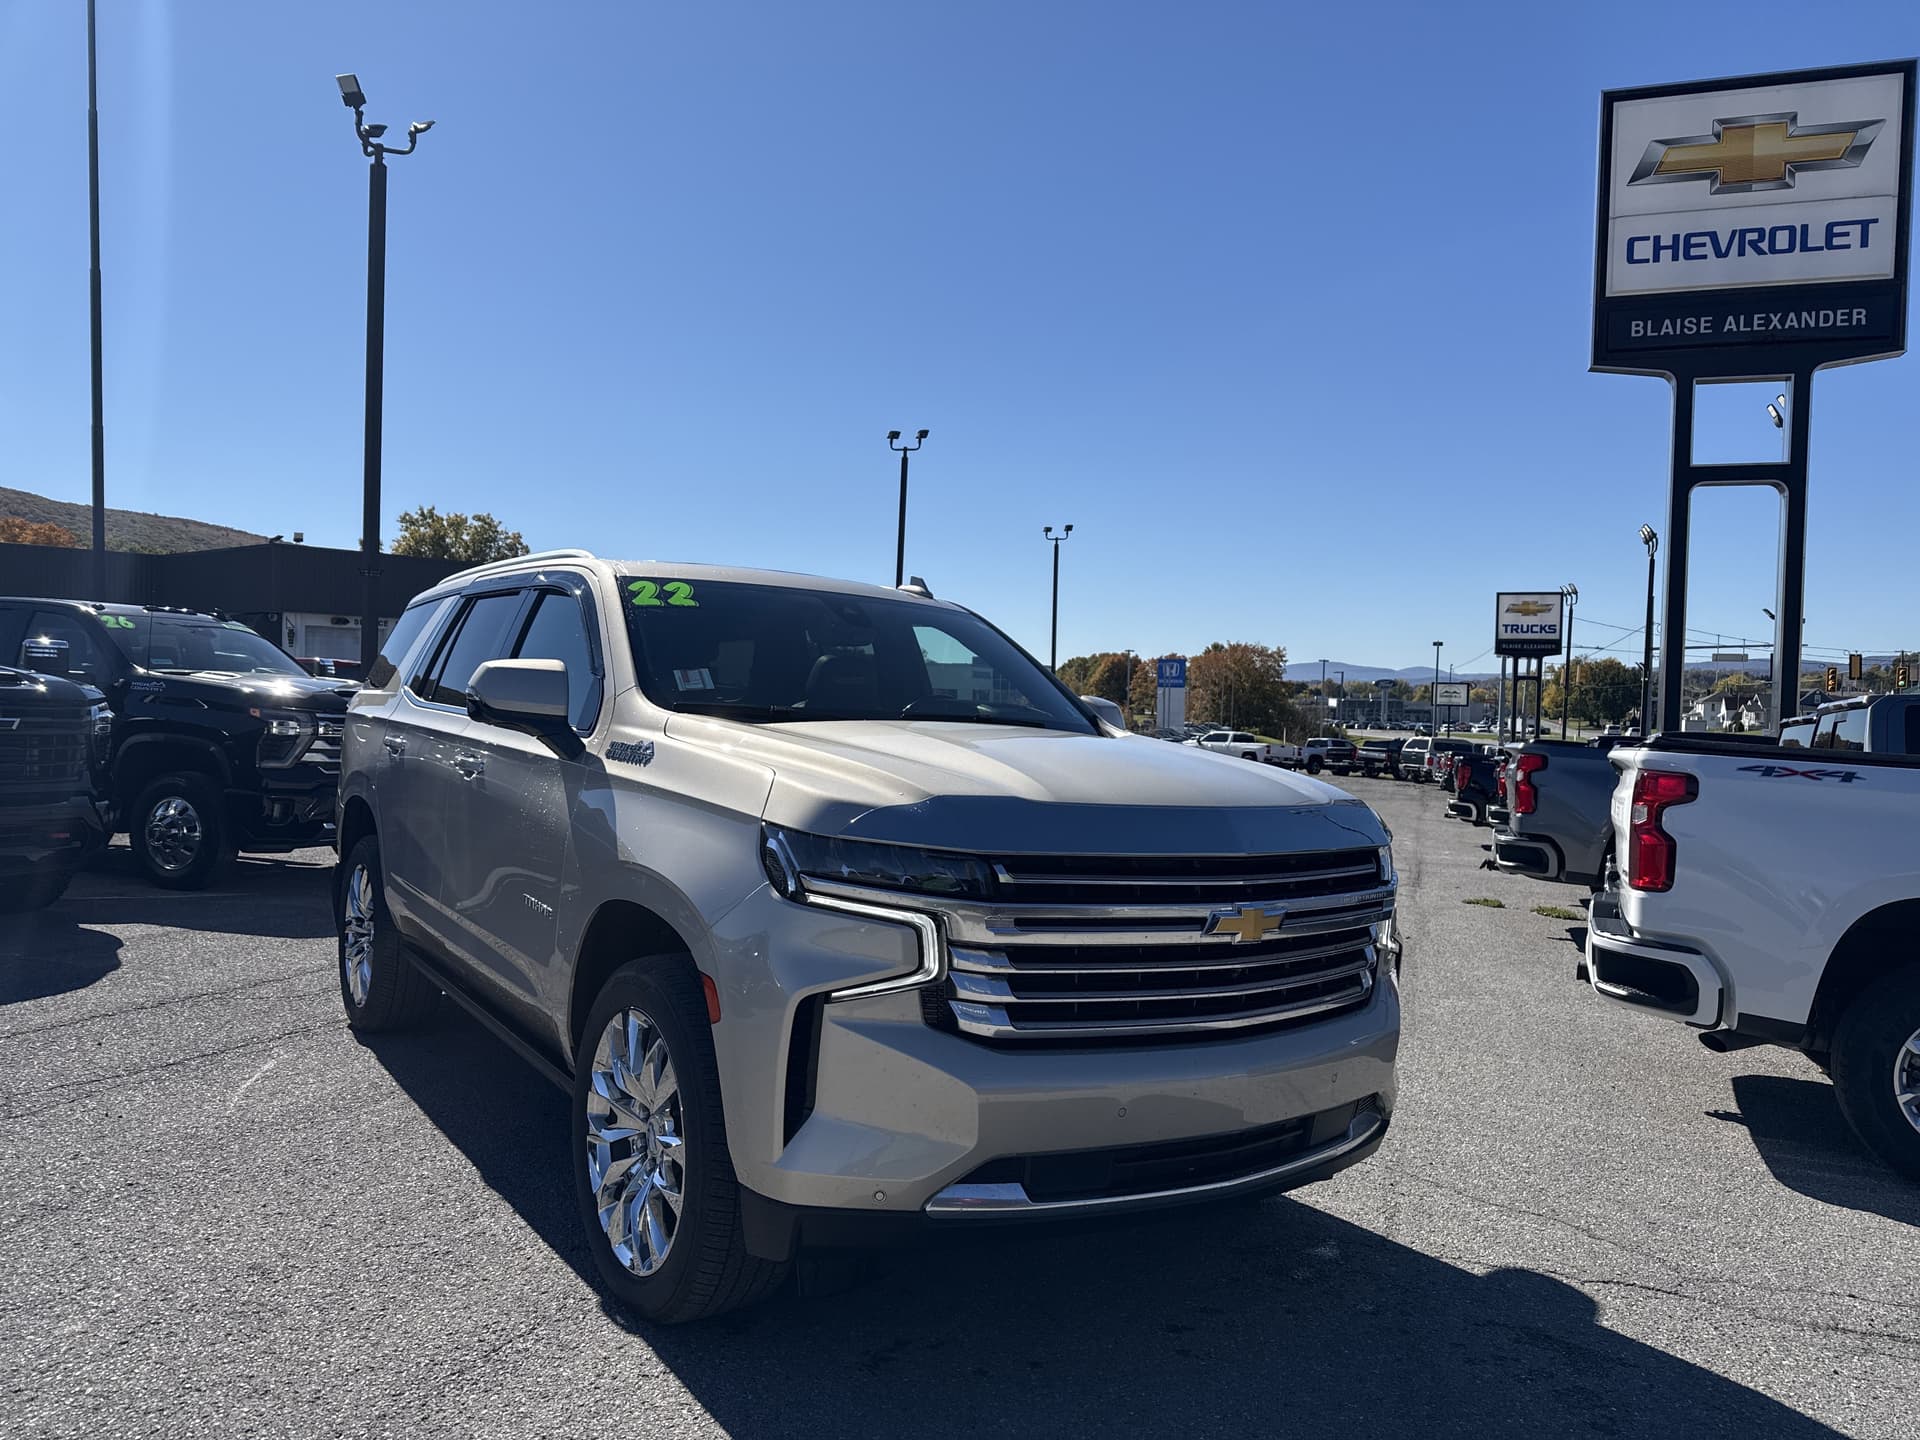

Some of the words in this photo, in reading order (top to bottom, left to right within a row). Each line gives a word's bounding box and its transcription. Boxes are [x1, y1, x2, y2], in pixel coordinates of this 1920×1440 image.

[1625, 217, 1879, 265] CHEVROLET
[1630, 315, 1714, 338] BLAISE
[1722, 307, 1867, 332] ALEXANDER
[627, 580, 700, 607] 22
[100, 614, 136, 629] 26
[1502, 623, 1557, 634] TRUCKS
